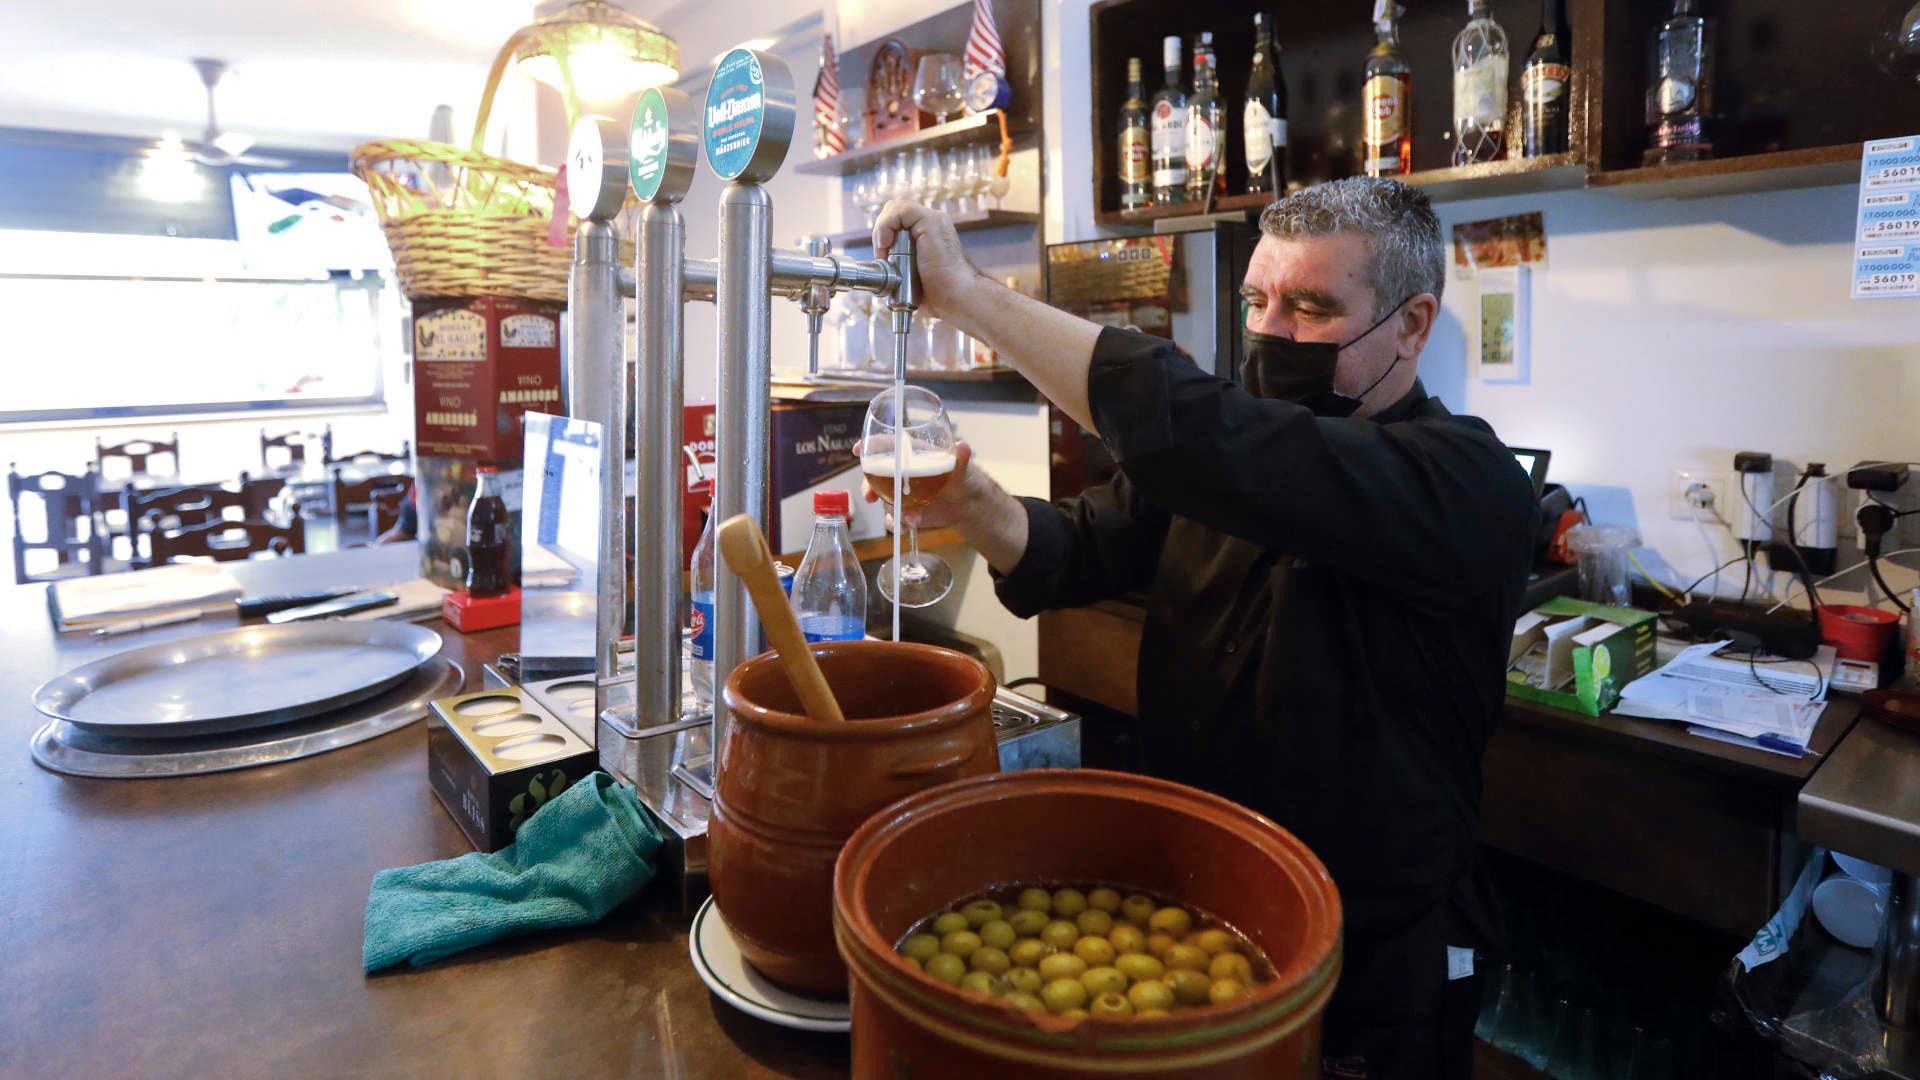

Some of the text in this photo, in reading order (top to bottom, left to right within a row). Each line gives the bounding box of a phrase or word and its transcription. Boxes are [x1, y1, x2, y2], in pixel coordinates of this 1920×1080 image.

[1883, 167, 1920, 178] 56019
[1879, 220, 1919, 231] 56019
[1874, 274, 1915, 284] 56019
[517, 375, 542, 386] VINO
[795, 441, 817, 455] LOS
